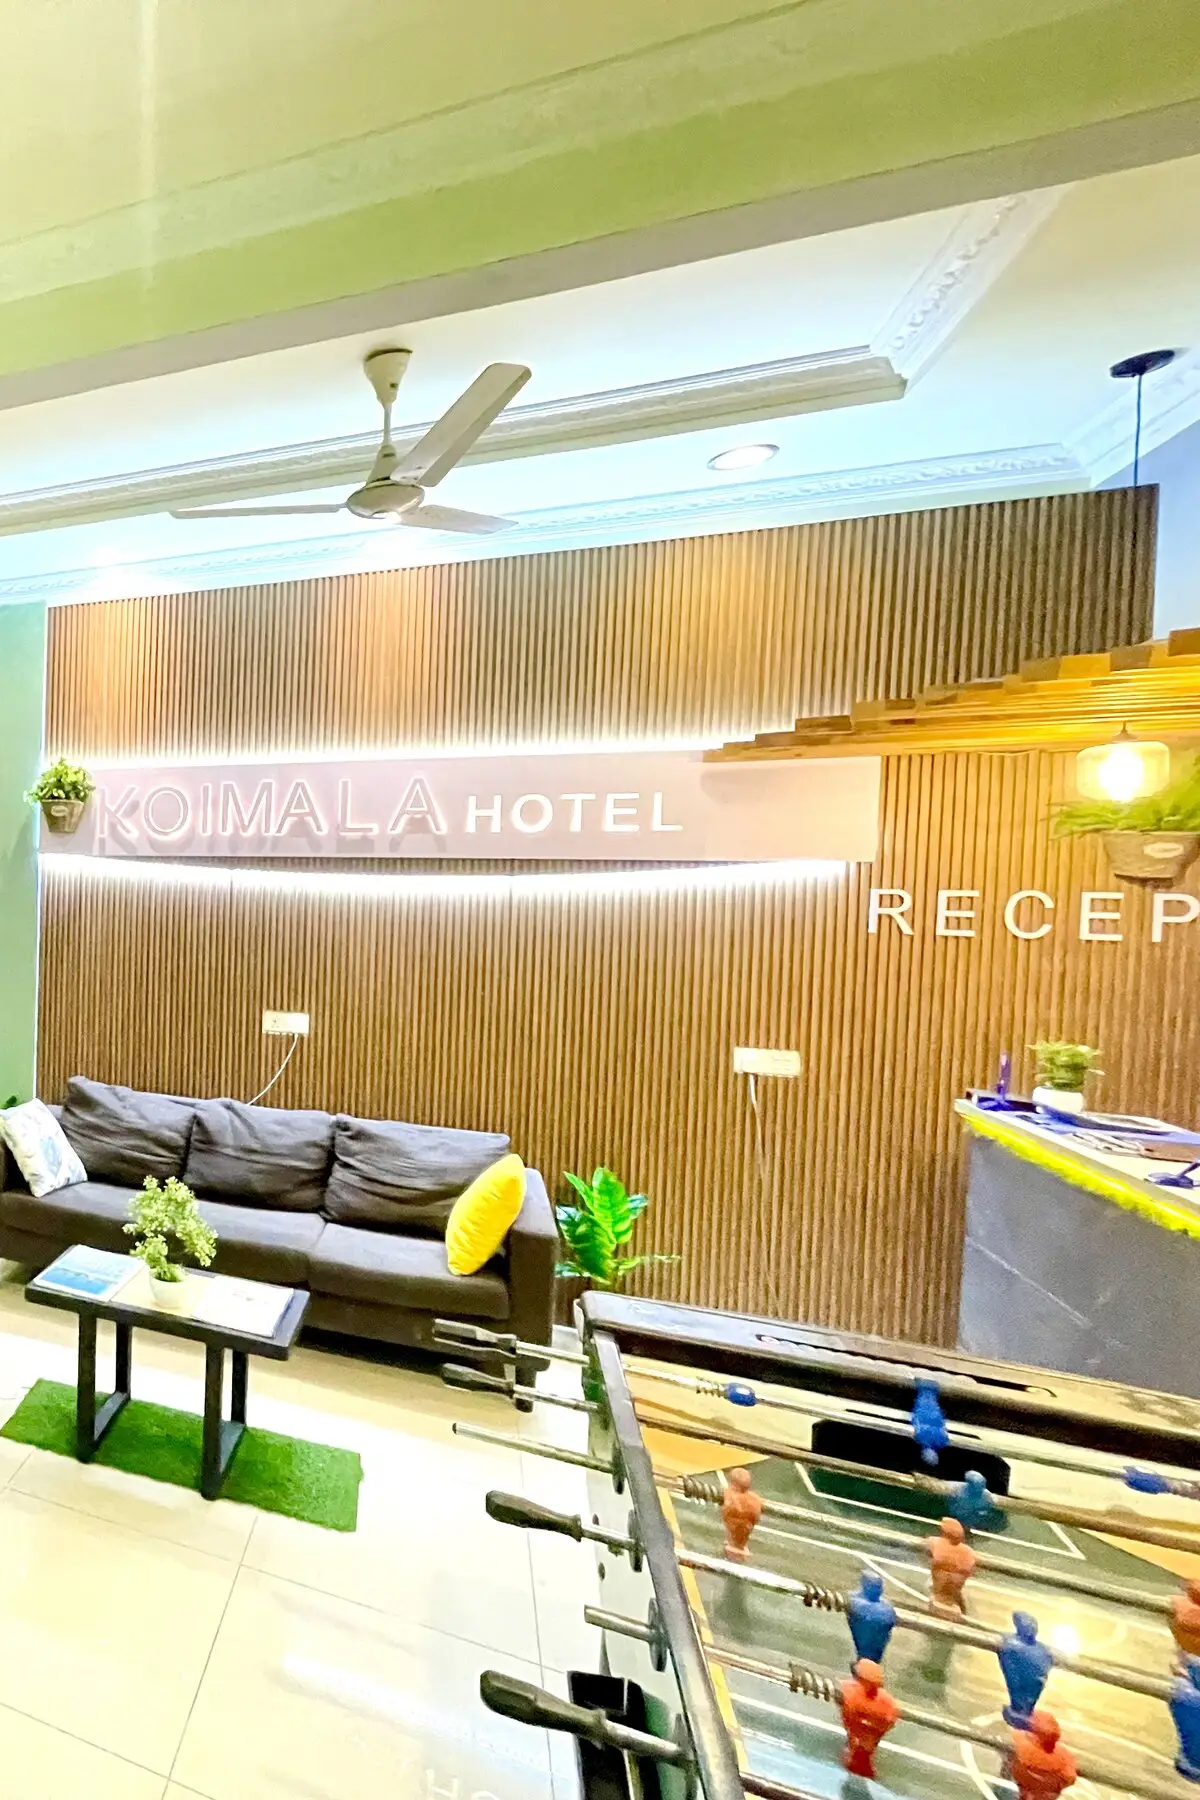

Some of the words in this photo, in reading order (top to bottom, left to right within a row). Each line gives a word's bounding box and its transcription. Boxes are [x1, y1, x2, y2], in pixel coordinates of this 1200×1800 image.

[97, 773, 447, 838] KOIMALA
[465, 791, 684, 834] HOTEL
[867, 887, 1200, 943] RECEP
